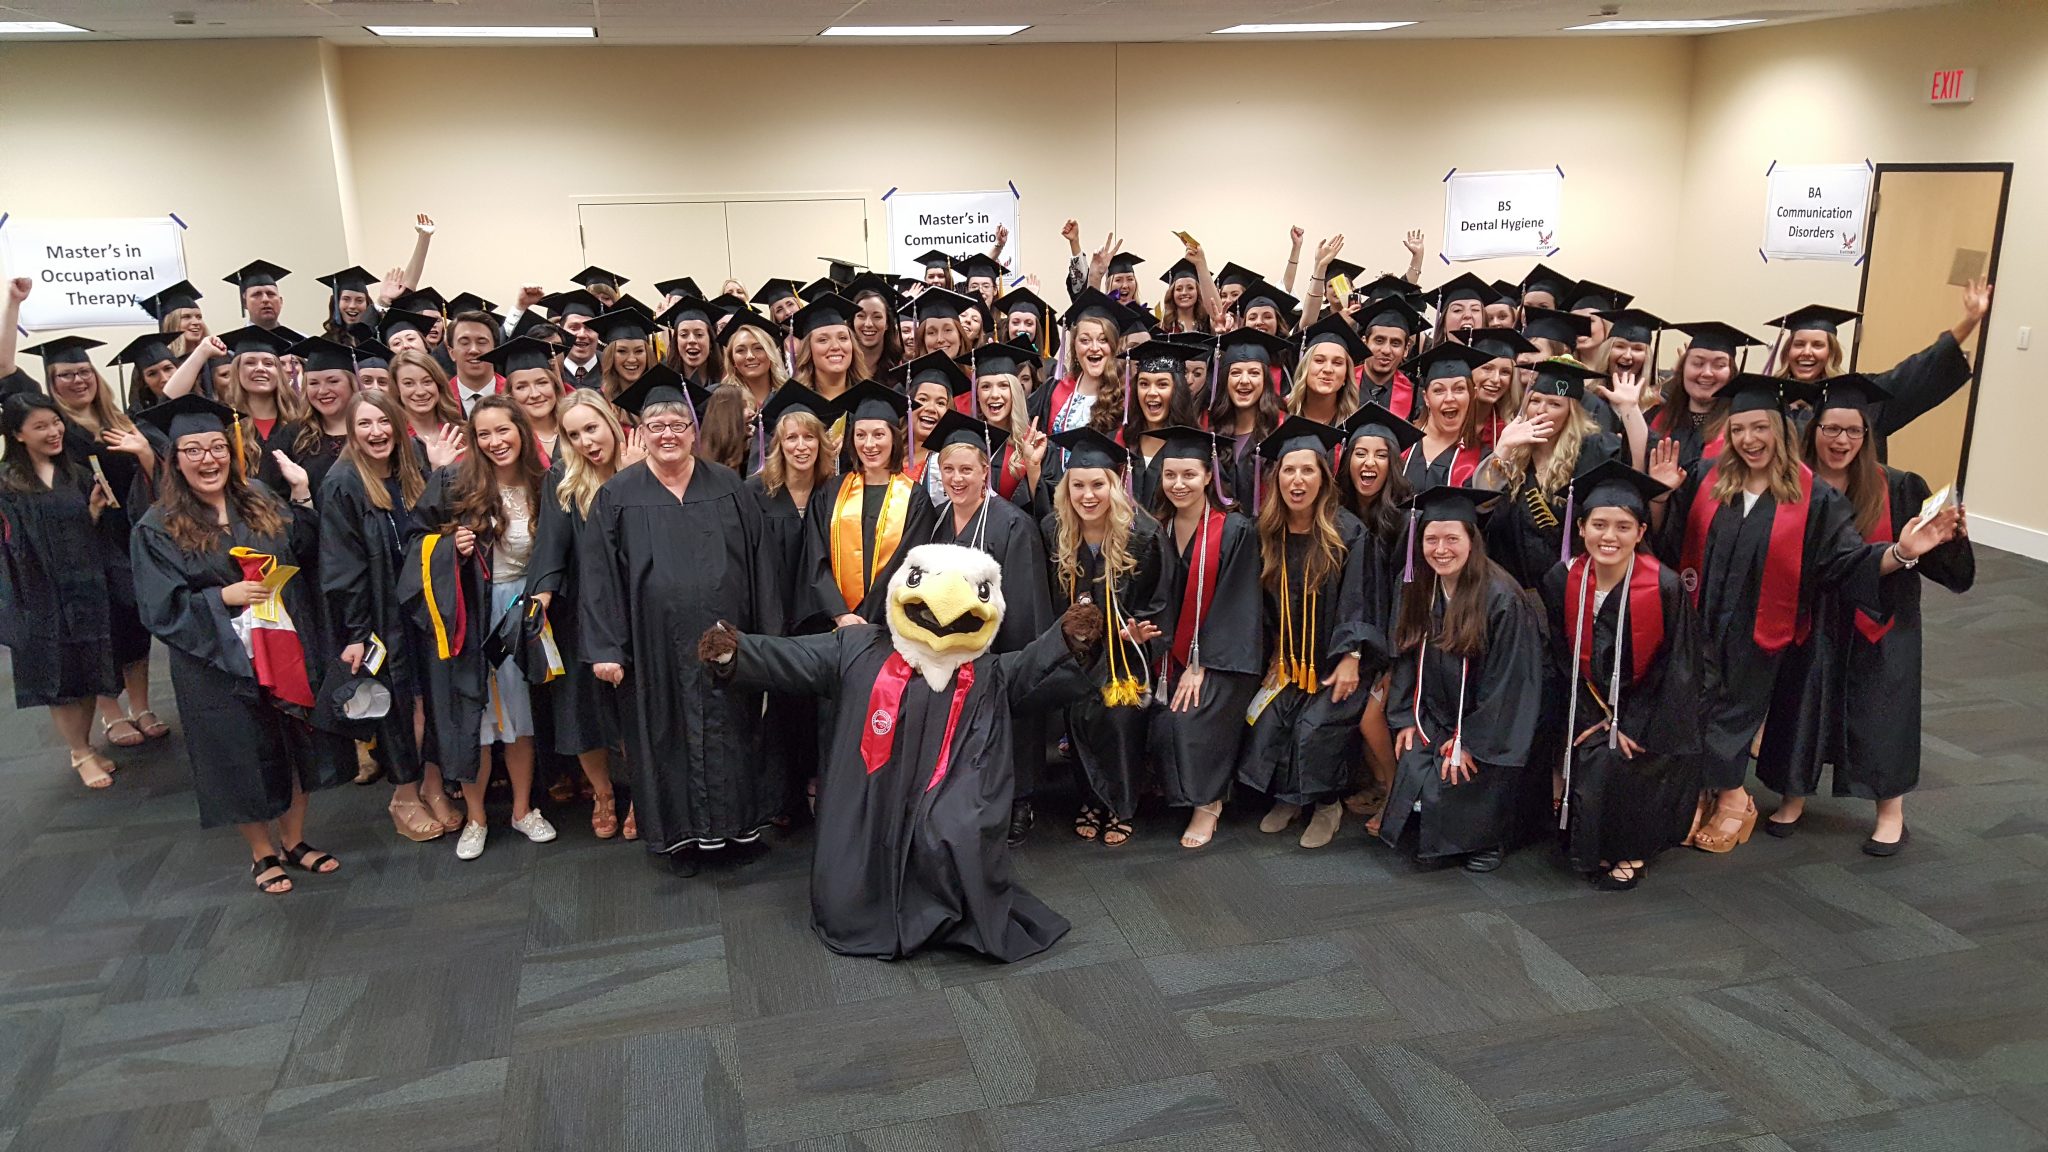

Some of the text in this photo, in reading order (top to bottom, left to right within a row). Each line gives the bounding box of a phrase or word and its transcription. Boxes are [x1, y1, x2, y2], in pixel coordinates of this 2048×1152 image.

[1931, 69, 1965, 100] EXIT
[1808, 187, 1822, 199] BA
[1498, 201, 1512, 212] BS
[1777, 206, 1853, 219] Communication
[919, 212, 990, 226] Master's in
[1461, 218, 1544, 232] Dental Hygiene
[904, 232, 997, 247] Communicatio
[1788, 226, 1835, 239] Disorders
[46, 244, 142, 259] Master's in
[41, 267, 155, 285] Occupational
[66, 292, 136, 307] Therapy
